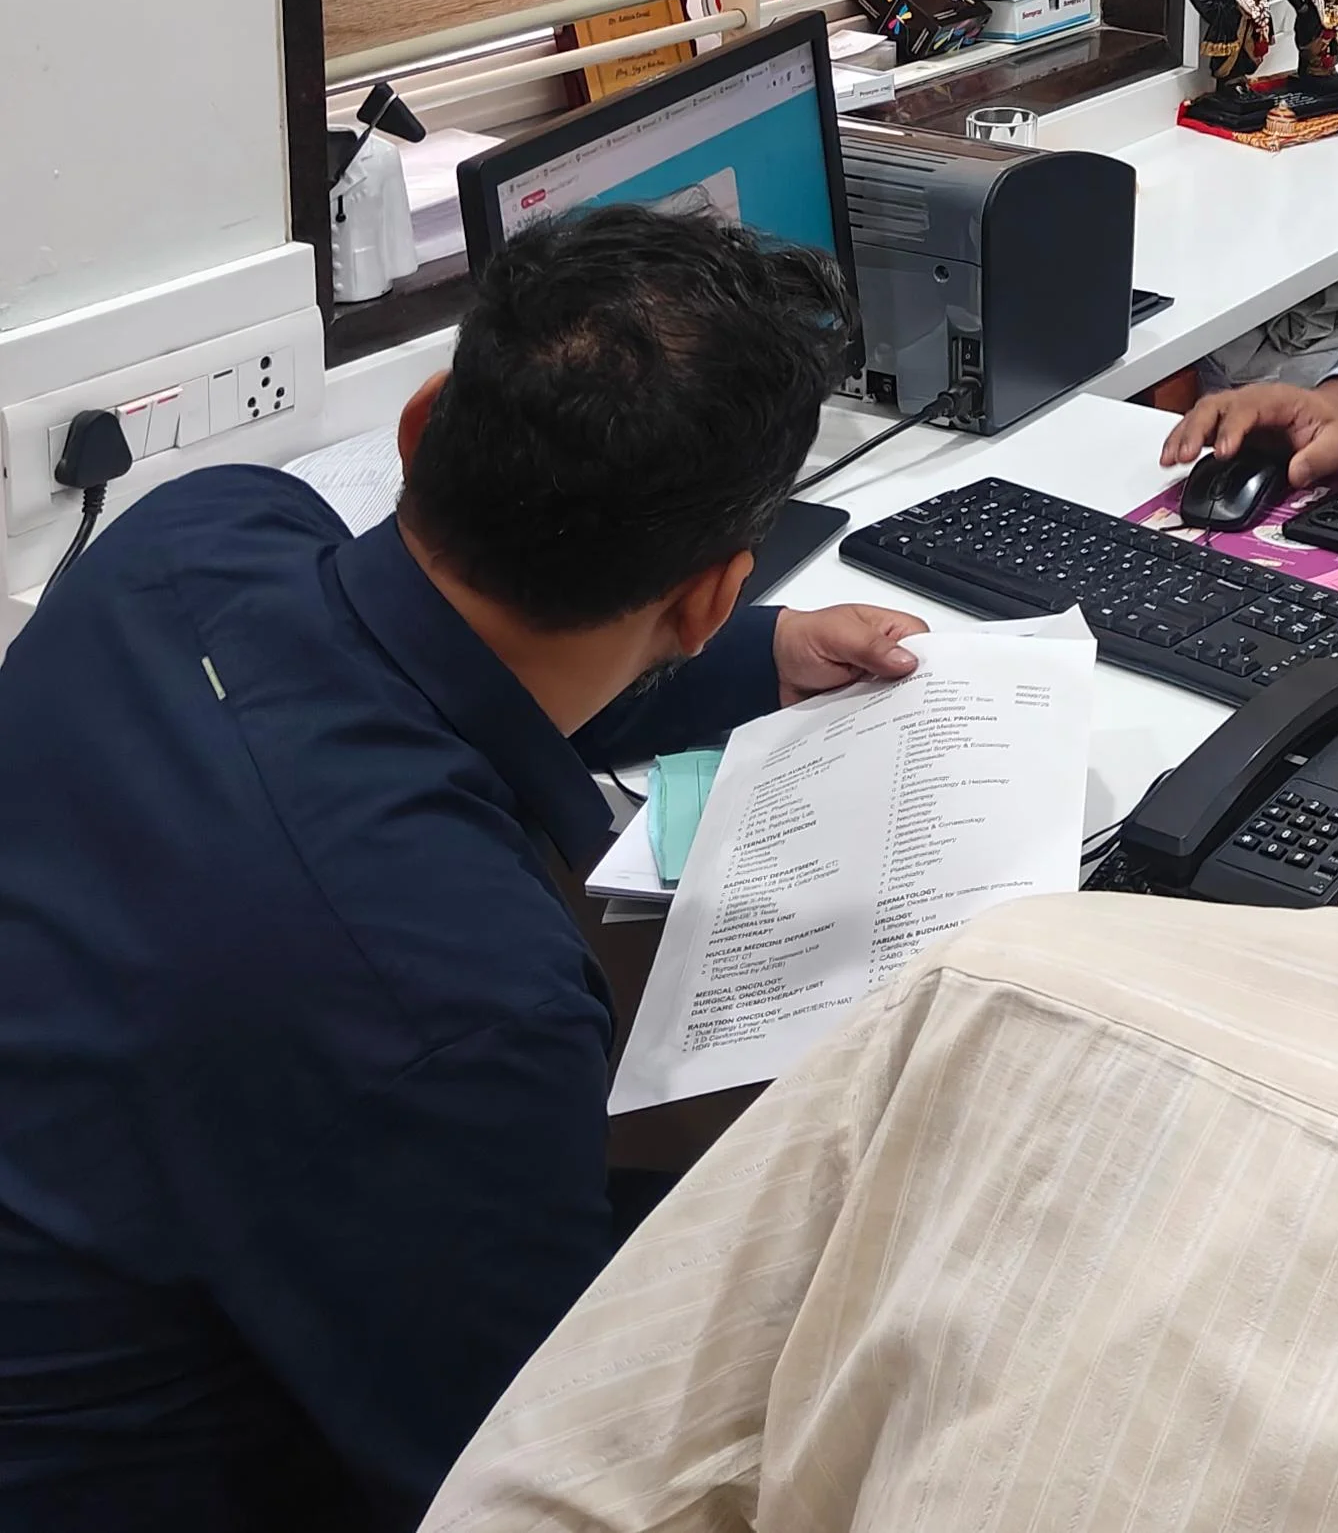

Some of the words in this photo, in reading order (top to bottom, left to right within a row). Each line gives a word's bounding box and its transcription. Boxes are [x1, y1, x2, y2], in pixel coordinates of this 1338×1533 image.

[733, 831, 781, 852] ALTERNATIVE
[770, 859, 819, 879] DEPARTMENT
[877, 887, 937, 907] DERMATOLOGY
[777, 912, 796, 922] UNIT
[874, 912, 913, 926] UROLOGY
[915, 921, 959, 937] BUDHRANI
[705, 947, 742, 959] NUCLEAR
[744, 939, 782, 951] MEDICINE
[784, 921, 836, 944] DEPARTMENT
[693, 994, 737, 1007] SURGICAL
[739, 984, 787, 998] ONCOLOGY
[695, 987, 733, 998] MEDICAL
[735, 977, 784, 991] ONCOLOGY
[691, 1008, 708, 1016] DAY
[710, 1004, 733, 1013] CARE
[735, 987, 804, 1009] CHEMOTHERAPY
[805, 981, 824, 991] UNIT
[687, 1017, 734, 1031] RADIATION
[736, 1008, 782, 1021] ONCOLOGY
